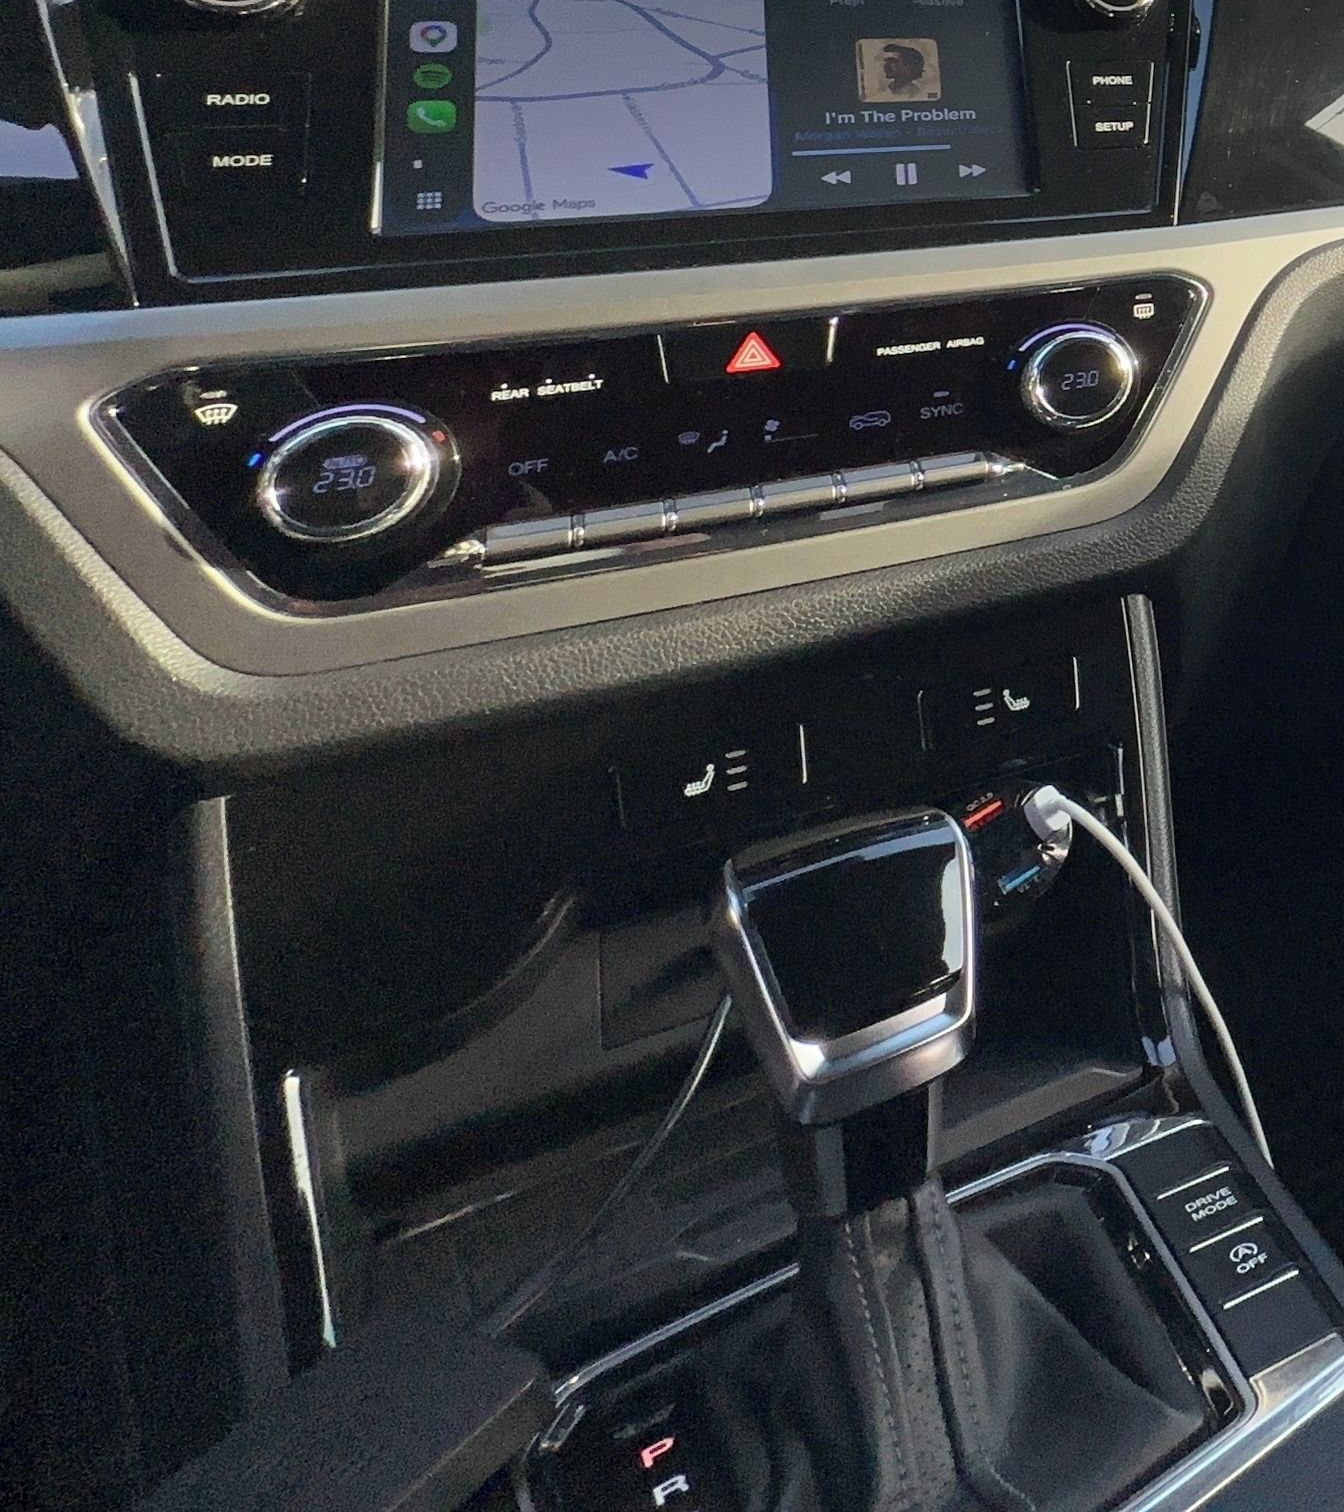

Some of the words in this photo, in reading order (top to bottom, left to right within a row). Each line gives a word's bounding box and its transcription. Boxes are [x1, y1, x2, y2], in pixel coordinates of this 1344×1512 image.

[1092, 75, 1134, 86] PHONE
[206, 93, 271, 106] RADIO
[825, 111, 856, 125] I'm
[860, 110, 896, 124] The
[902, 108, 977, 123] Problem
[1095, 121, 1135, 133] SETUP
[212, 154, 274, 168] MODE
[482, 200, 545, 215] Google
[552, 198, 596, 212] Maps
[876, 341, 941, 356] PASSENGER
[946, 336, 985, 348] AIRBAG
[491, 387, 530, 401] REAR
[537, 379, 604, 396] SEATBELT
[920, 402, 963, 420] SYNC
[602, 446, 640, 464] A/C
[508, 458, 550, 477] OFF
[1184, 1186, 1233, 1213] DRIVE
[1191, 1195, 1238, 1222] MODE
[1236, 1251, 1268, 1274] OFF
[641, 1437, 675, 1468] P
[652, 1474, 690, 1506] R
